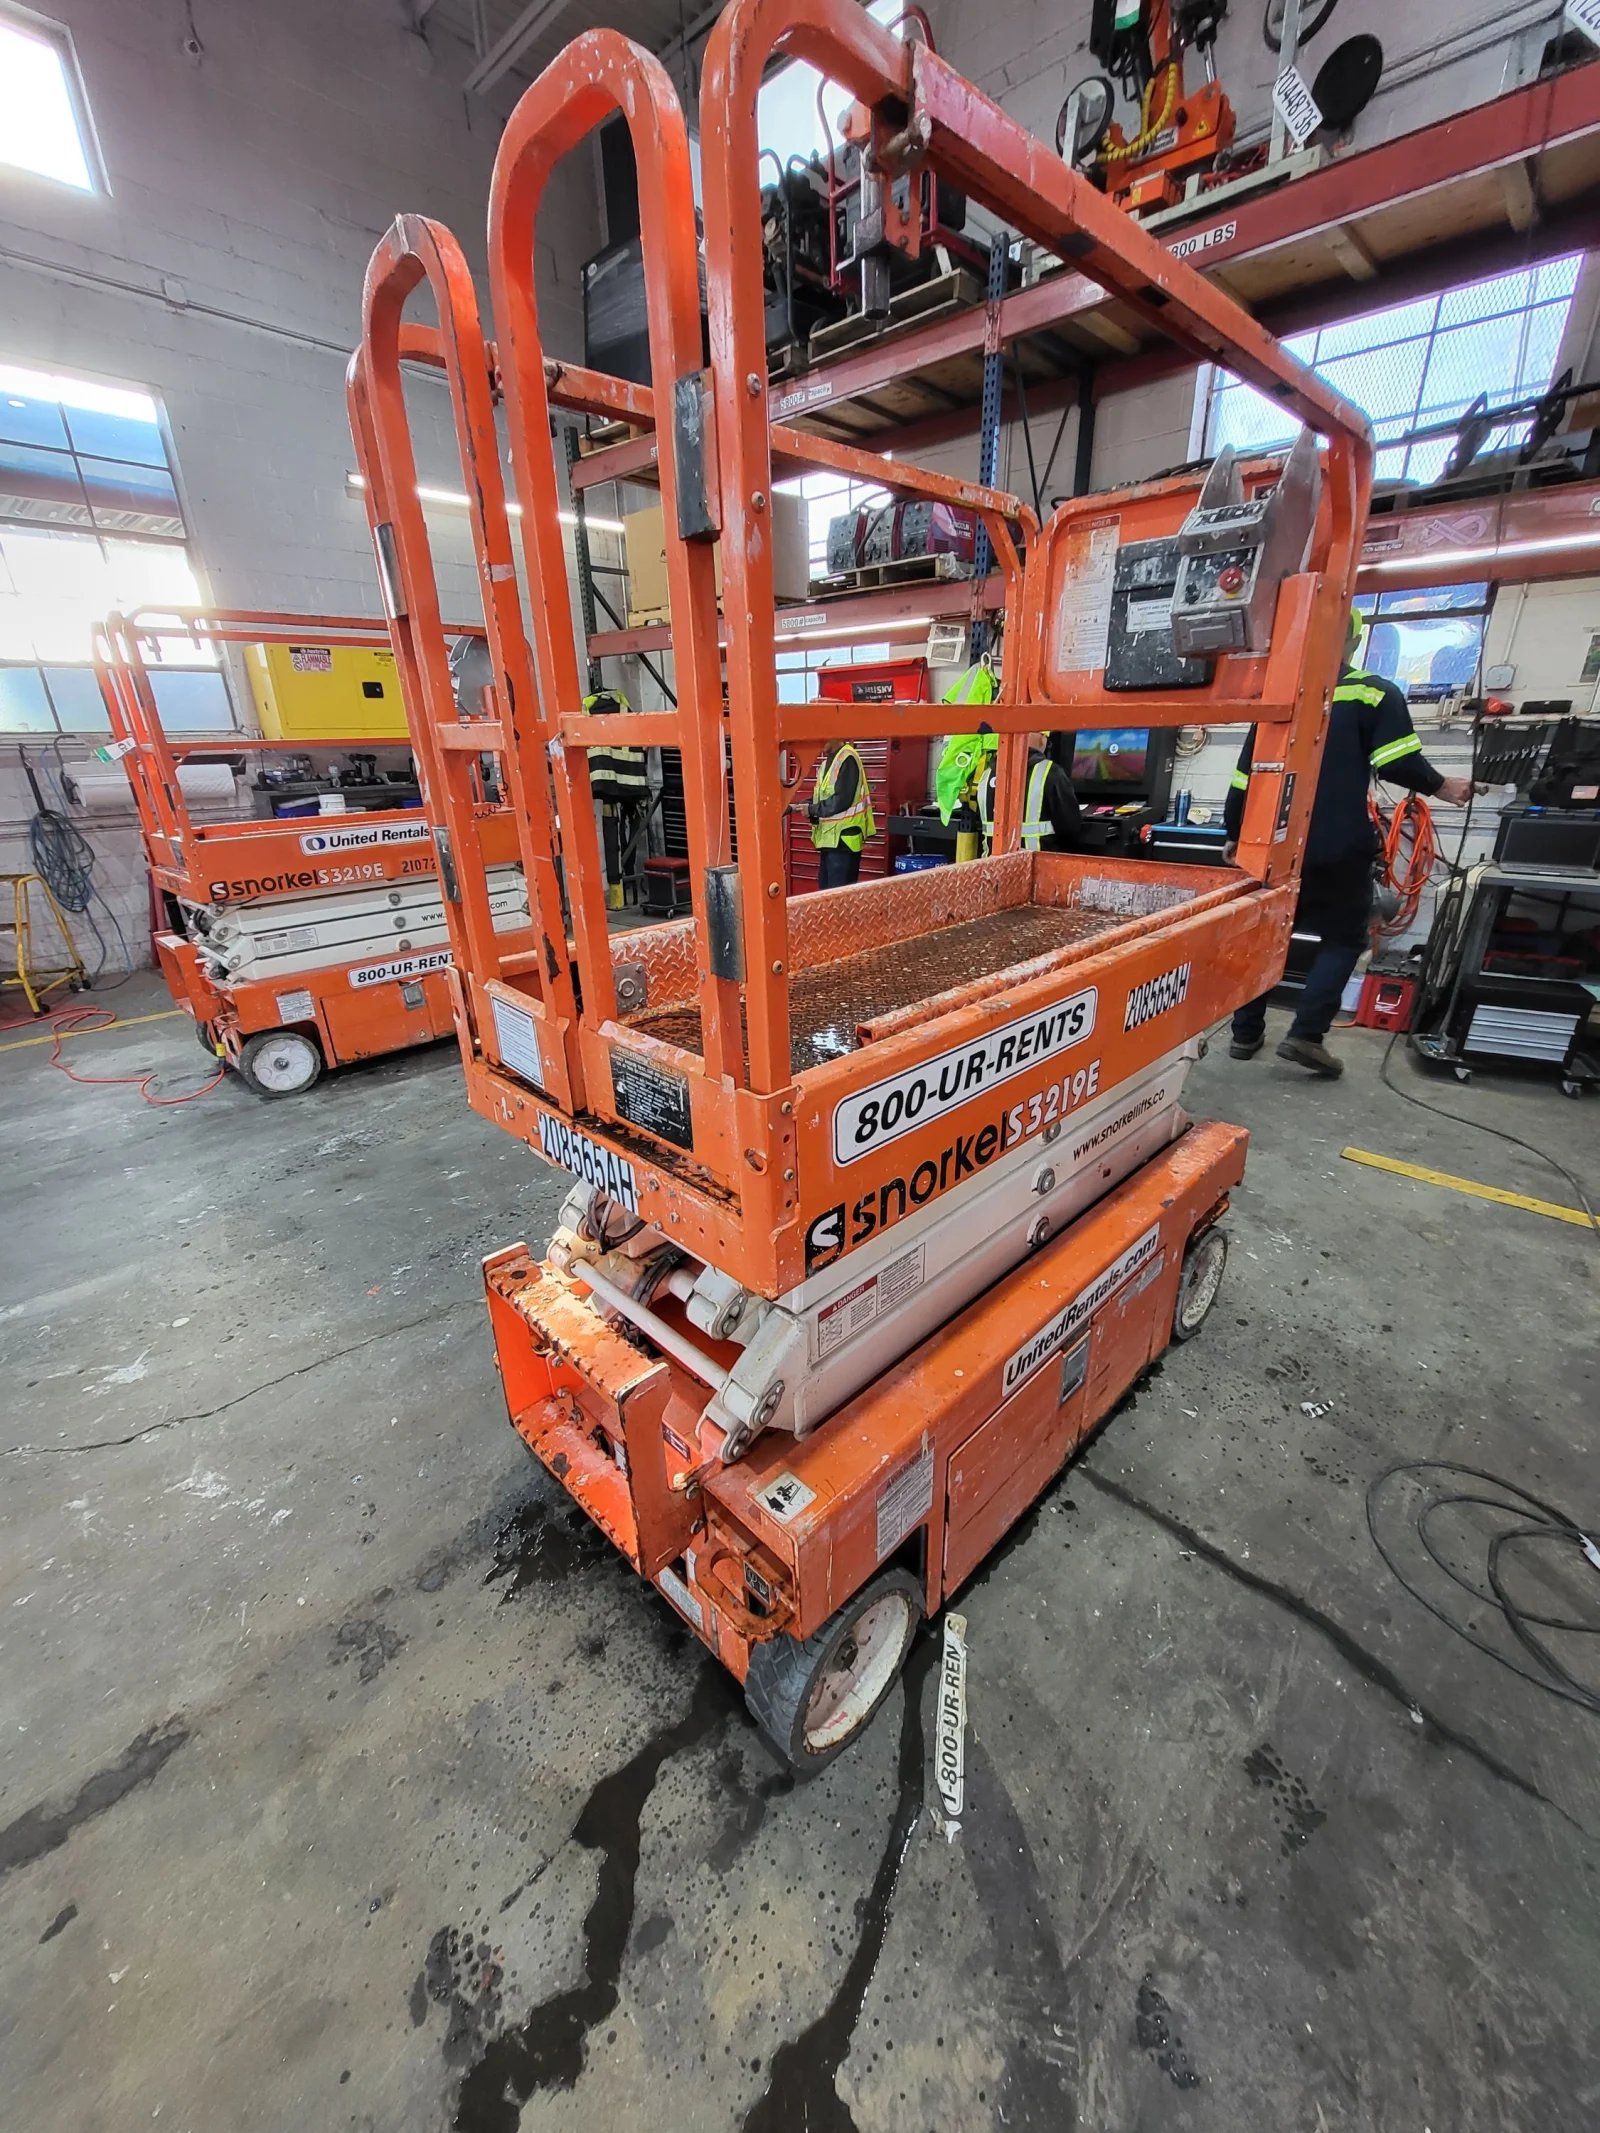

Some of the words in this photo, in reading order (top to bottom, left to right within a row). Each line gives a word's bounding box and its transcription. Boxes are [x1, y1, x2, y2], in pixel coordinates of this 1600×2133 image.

[1203, 224, 1235, 247] LBS
[782, 617, 804, 628] 5800#
[805, 615, 825, 624] capacity
[301, 654, 332, 665] FLAMMABLE
[864, 684, 893, 695] HUSKY
[329, 829, 378, 848] United
[382, 825, 430, 841] Rentals
[231, 869, 319, 897] snorkel
[318, 862, 384, 884] S3219E
[421, 912, 446, 921] www.
[1125, 963, 1189, 1033] 208565AH
[855, 1002, 1087, 1145] 800-UR-RENTS
[1006, 1059, 1101, 1147] S3219E
[539, 1112, 635, 1213] 208565AH
[851, 1111, 1009, 1245] snorkel
[837, 1284, 865, 1309] DANGER
[1006, 1234, 1157, 1387] UnitedRentals.com
